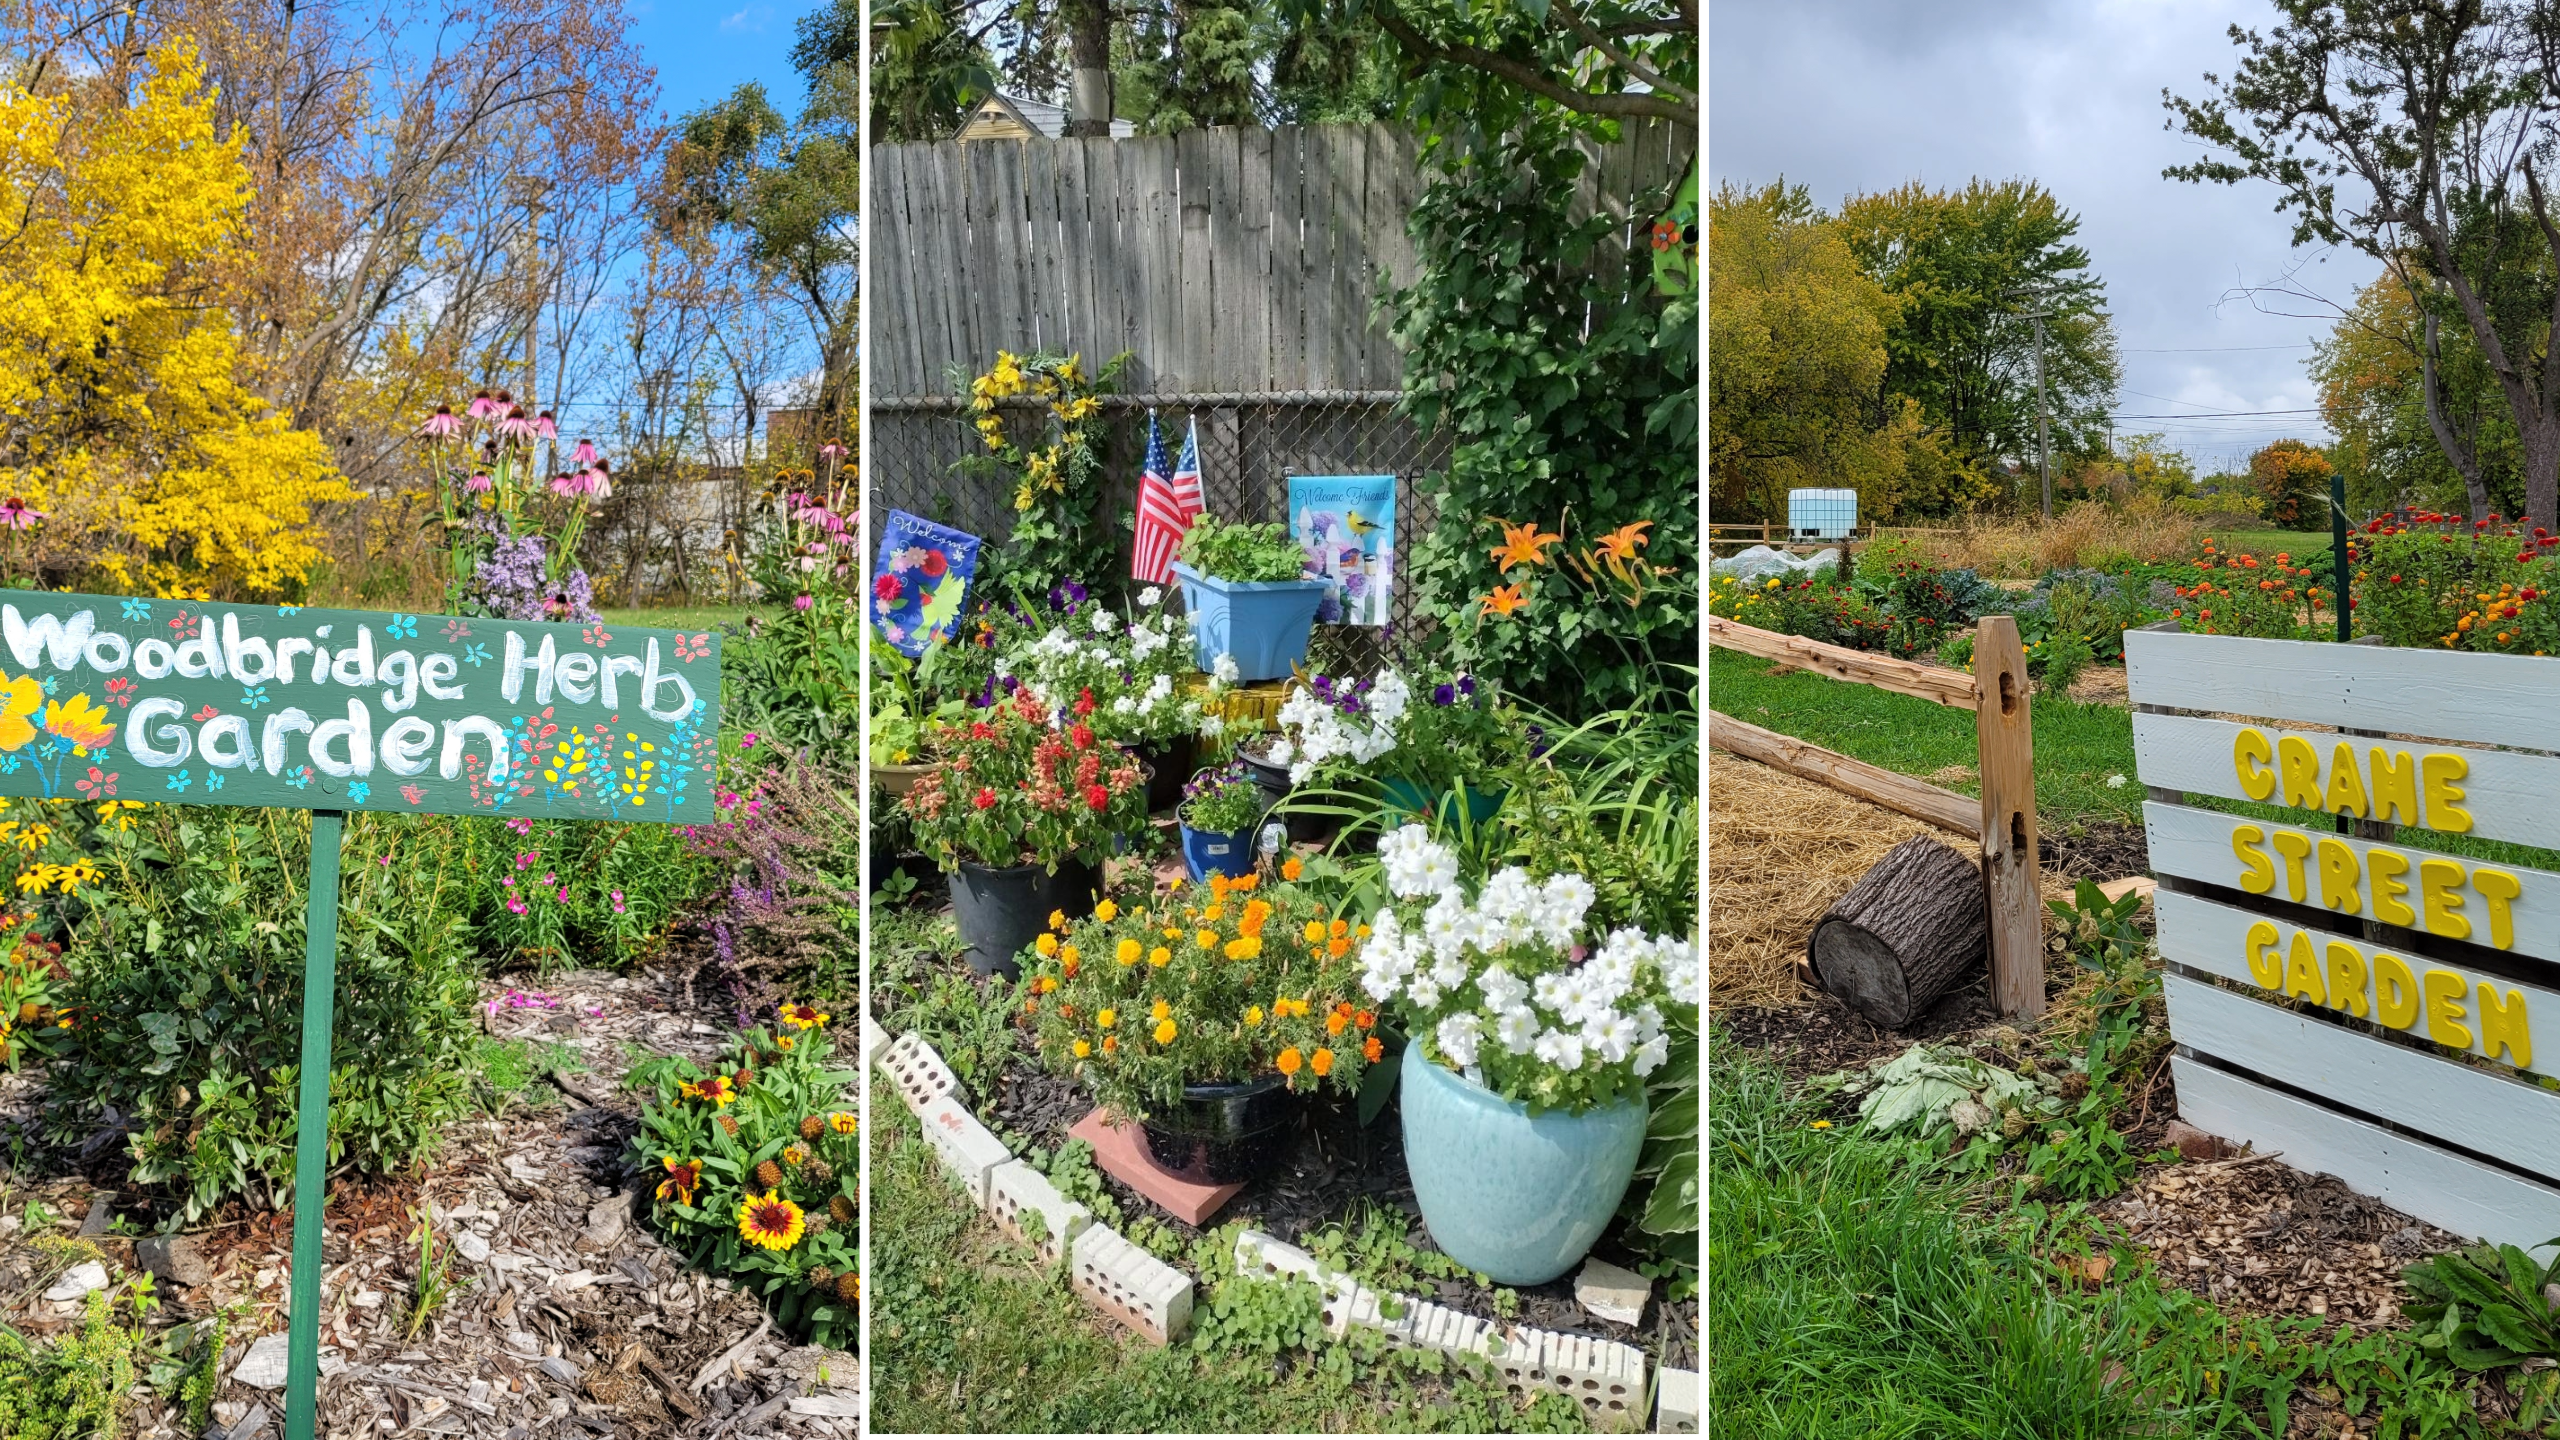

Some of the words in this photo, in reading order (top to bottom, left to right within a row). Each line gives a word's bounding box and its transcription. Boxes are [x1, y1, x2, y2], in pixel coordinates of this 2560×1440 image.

[893, 516, 970, 552] Welcome
[1295, 486, 1344, 506] Welcome
[1346, 486, 1390, 506] Friends
[0, 602, 467, 714] Woodbridge
[501, 629, 697, 724] Herb
[124, 696, 510, 788] Garden
[2233, 728, 2474, 833] CRANE
[2232, 825, 2521, 951] STREET
[2246, 921, 2532, 1069] GARDEN
